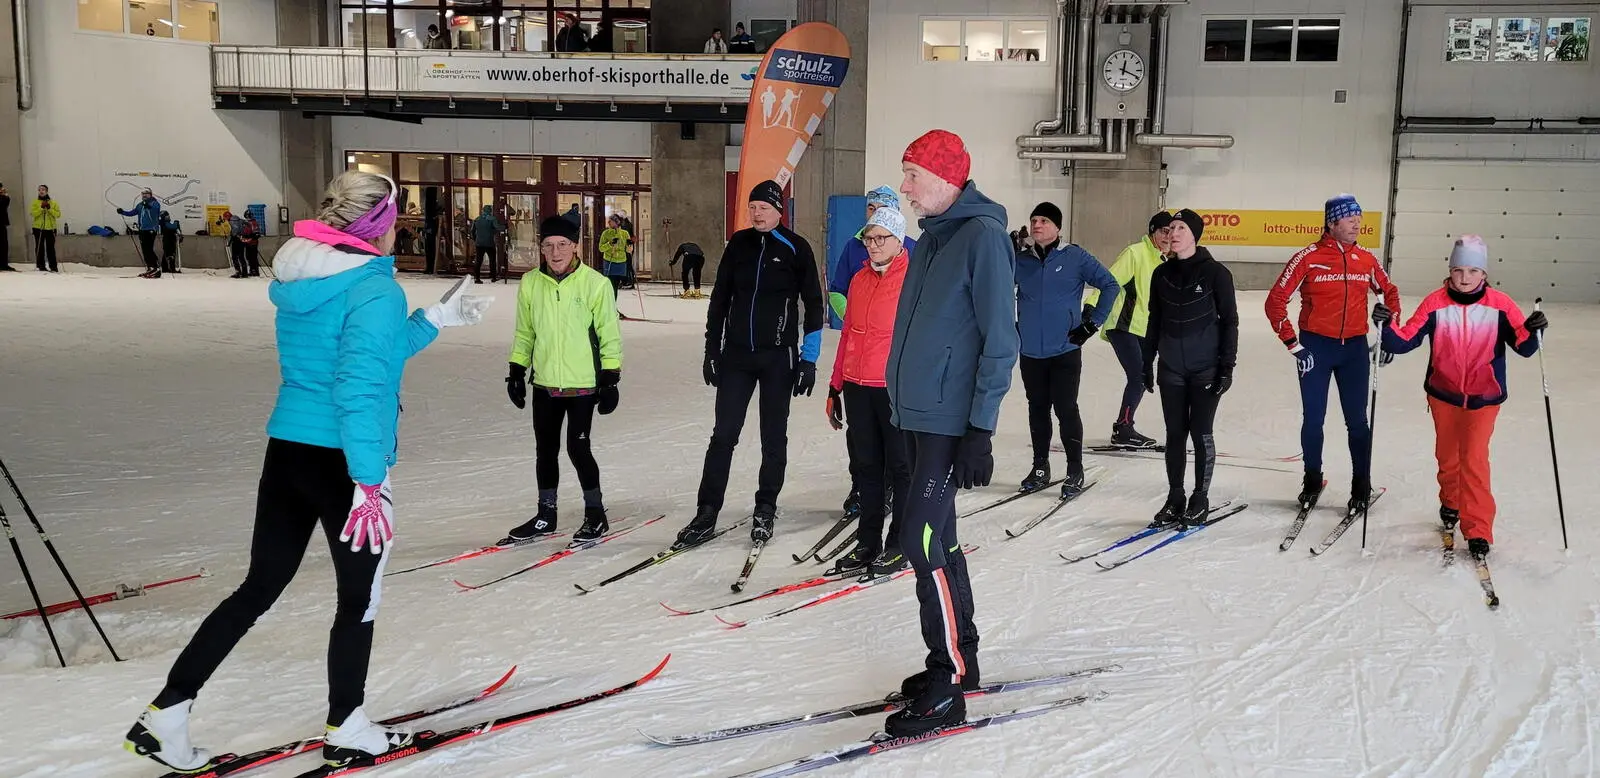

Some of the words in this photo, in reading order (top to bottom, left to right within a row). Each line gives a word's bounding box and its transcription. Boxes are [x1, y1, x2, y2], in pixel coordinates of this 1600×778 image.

[777, 55, 832, 74] schulz
[487, 66, 729, 87] www.oberhof-skisporthalle.de
[783, 69, 834, 83] sportreisen
[1202, 214, 1241, 227] OTTO
[1280, 247, 1312, 288] MARCIALONGA
[924, 479, 935, 497] GORE
[374, 747, 420, 765] ROSSIGNOL
